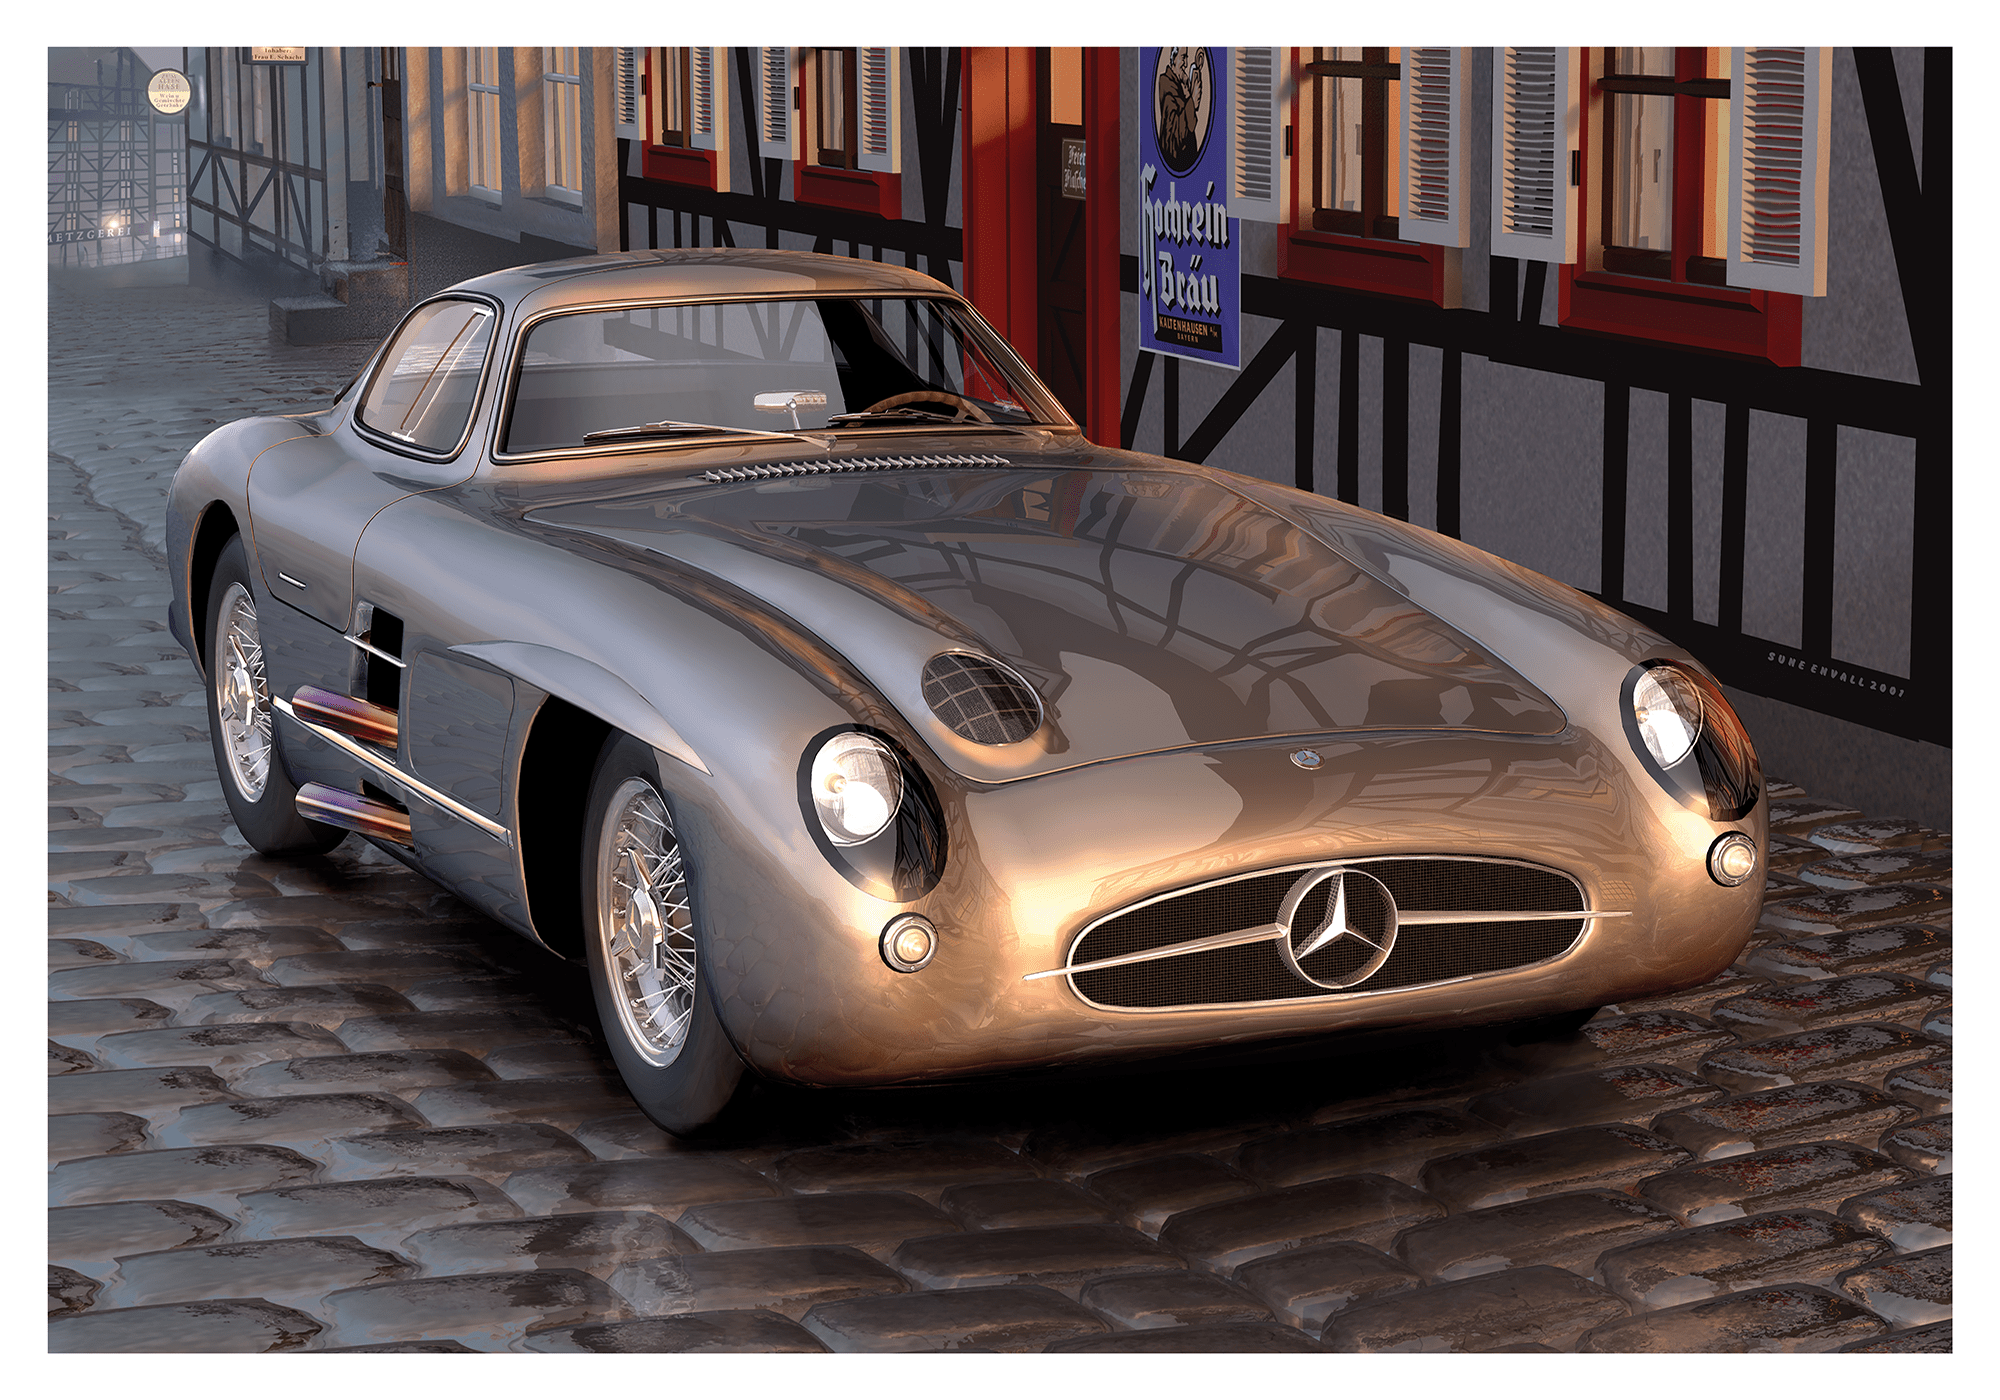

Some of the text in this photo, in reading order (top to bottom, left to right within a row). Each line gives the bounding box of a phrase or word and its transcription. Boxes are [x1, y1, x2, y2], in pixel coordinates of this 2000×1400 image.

[1159, 251, 1221, 316] Bräu
[1158, 316, 1208, 336] KALTENHAUSEN
[1177, 332, 1199, 343] BAYERN
